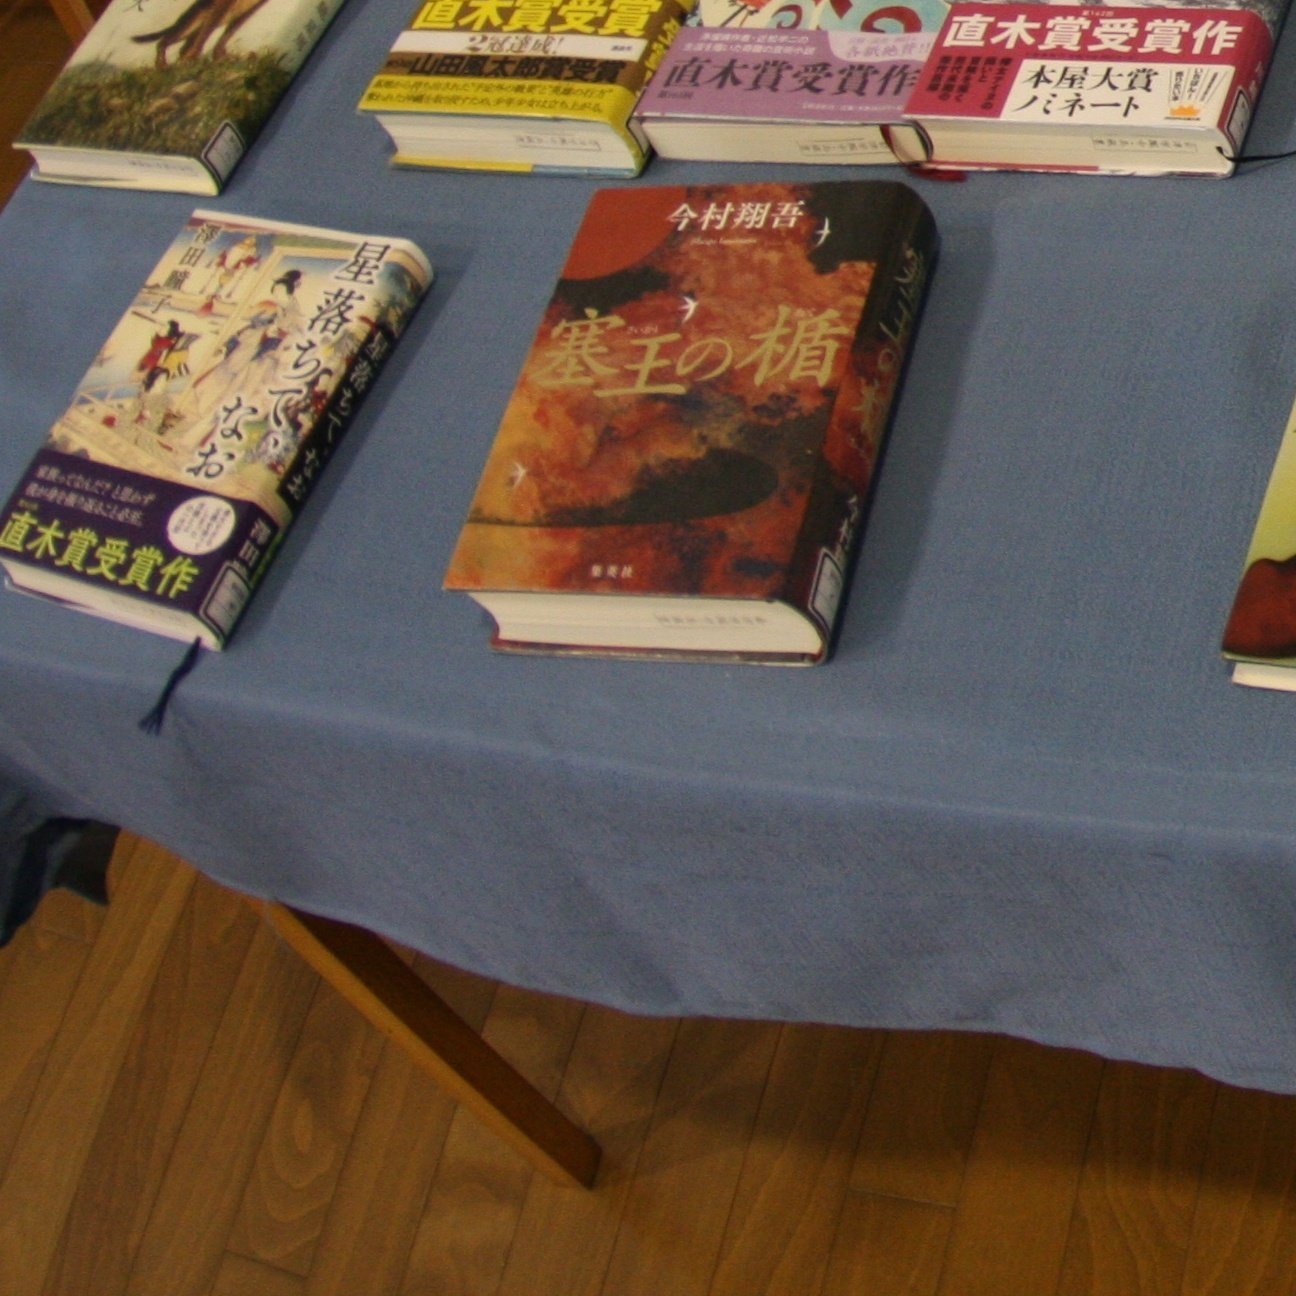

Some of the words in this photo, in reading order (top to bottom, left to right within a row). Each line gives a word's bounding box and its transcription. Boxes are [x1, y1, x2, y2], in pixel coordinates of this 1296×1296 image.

[943, 14, 1243, 55] 直木賞受賞作
[409, 54, 626, 83] 山田風太郎賞受賞
[663, 56, 922, 97] 直木賞受賞作
[1023, 65, 1159, 93] 本屋大賞
[1013, 94, 1140, 117] ノミネート
[666, 201, 806, 231] 今村翔吾
[150, 223, 223, 313] 澤田瞳子
[527, 305, 853, 398] 塞王の楯
[0, 511, 199, 599] 直木賞受賞作
[591, 564, 634, 579] 集英社
